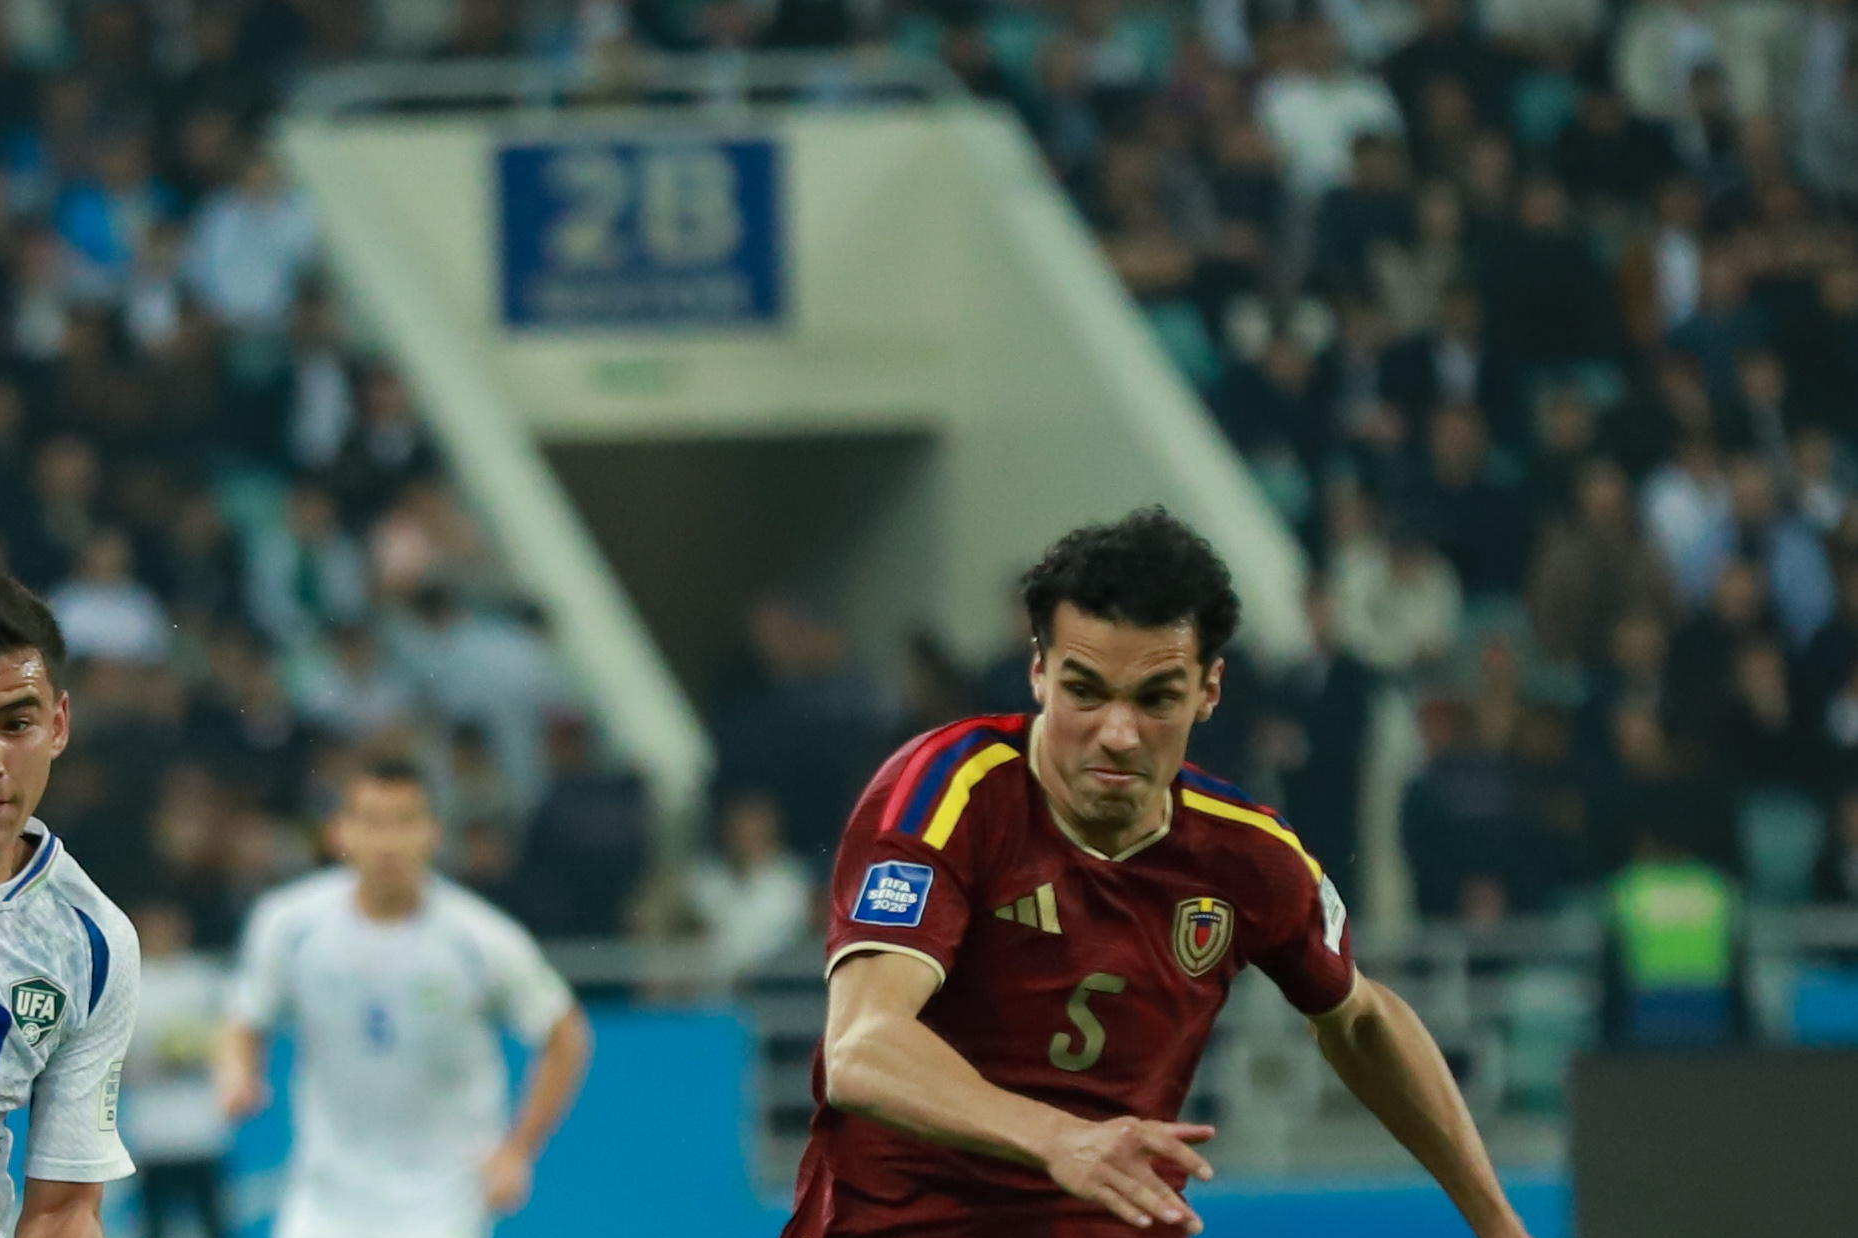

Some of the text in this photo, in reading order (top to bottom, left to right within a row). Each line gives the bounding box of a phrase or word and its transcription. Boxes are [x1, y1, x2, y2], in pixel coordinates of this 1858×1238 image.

[881, 877, 911, 893] FIFA
[867, 888, 919, 904] SERIES
[871, 899, 910, 913] 2026
[16, 990, 56, 1021] UFA
[1049, 973, 1128, 1072] 5
